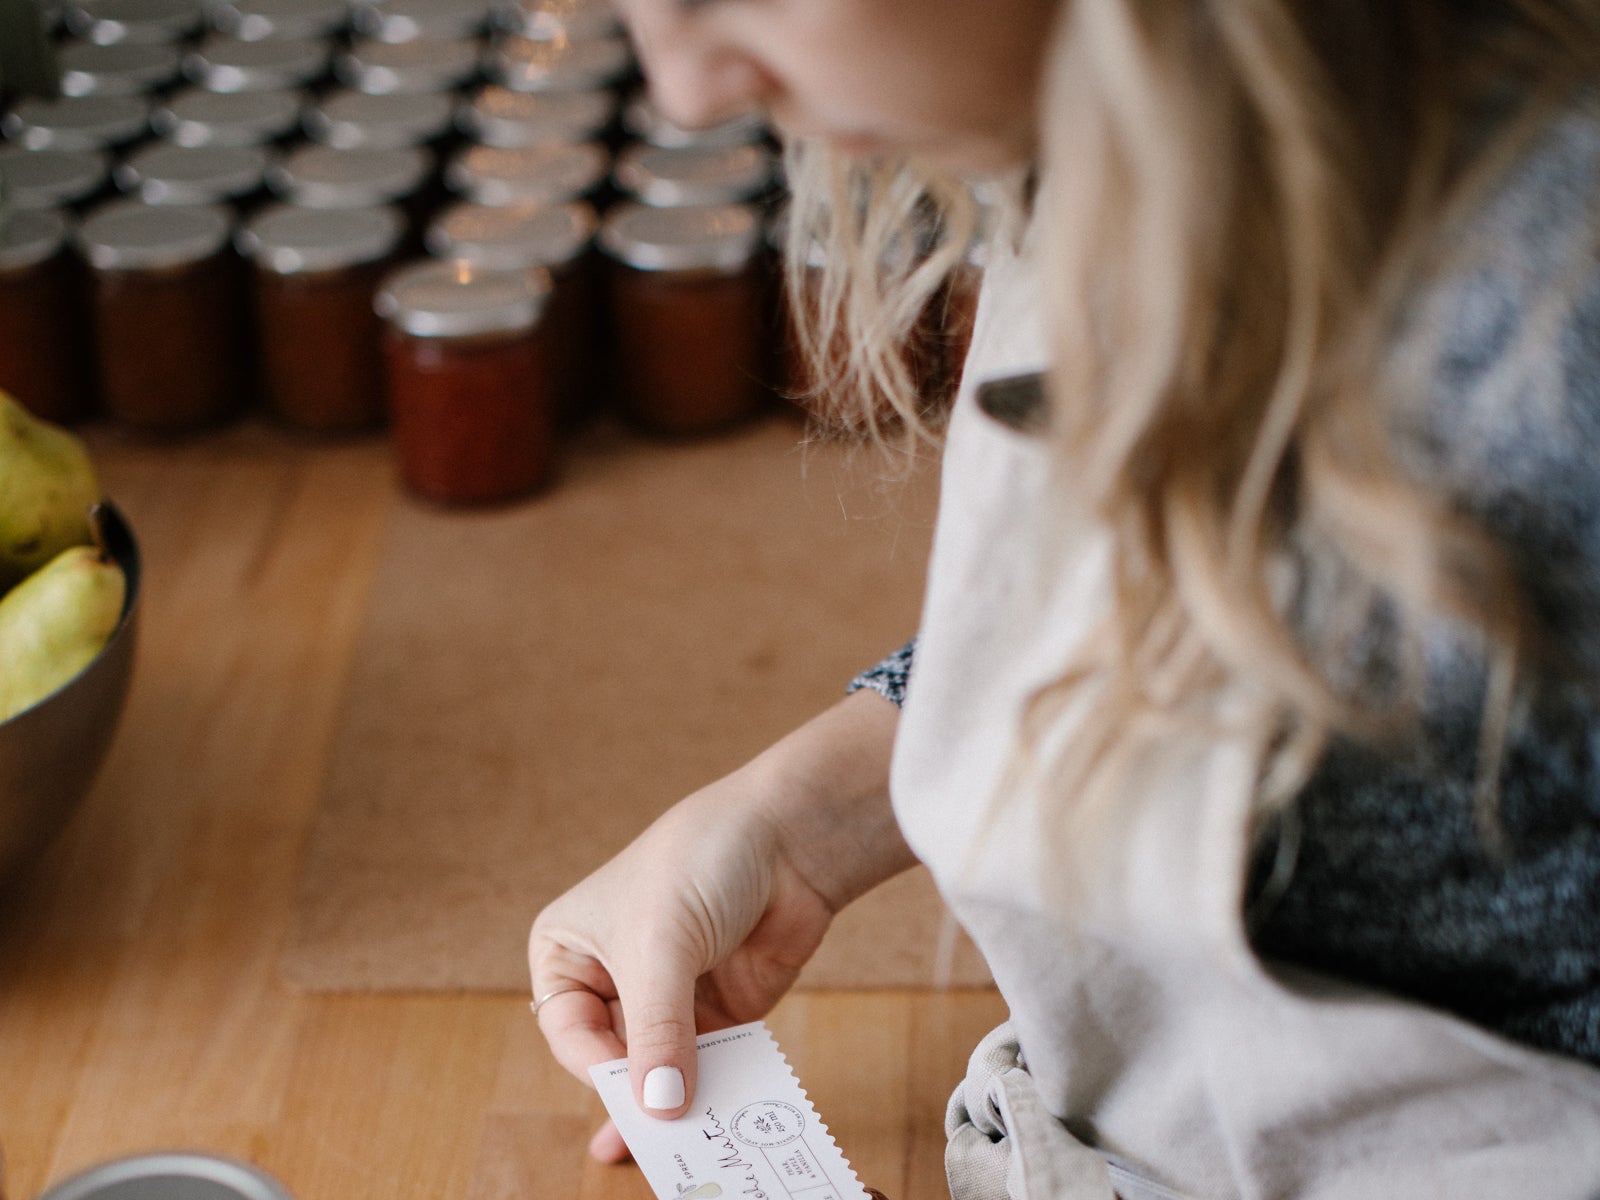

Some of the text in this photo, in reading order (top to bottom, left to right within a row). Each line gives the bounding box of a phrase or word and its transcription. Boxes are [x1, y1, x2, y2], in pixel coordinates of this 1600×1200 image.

[765, 1111, 777, 1121] ml
[702, 1106, 753, 1171] Matin
[674, 1153, 694, 1180] SPREAD
[788, 1156, 804, 1176] MAPLE
[794, 1149, 811, 1173] VANILLA
